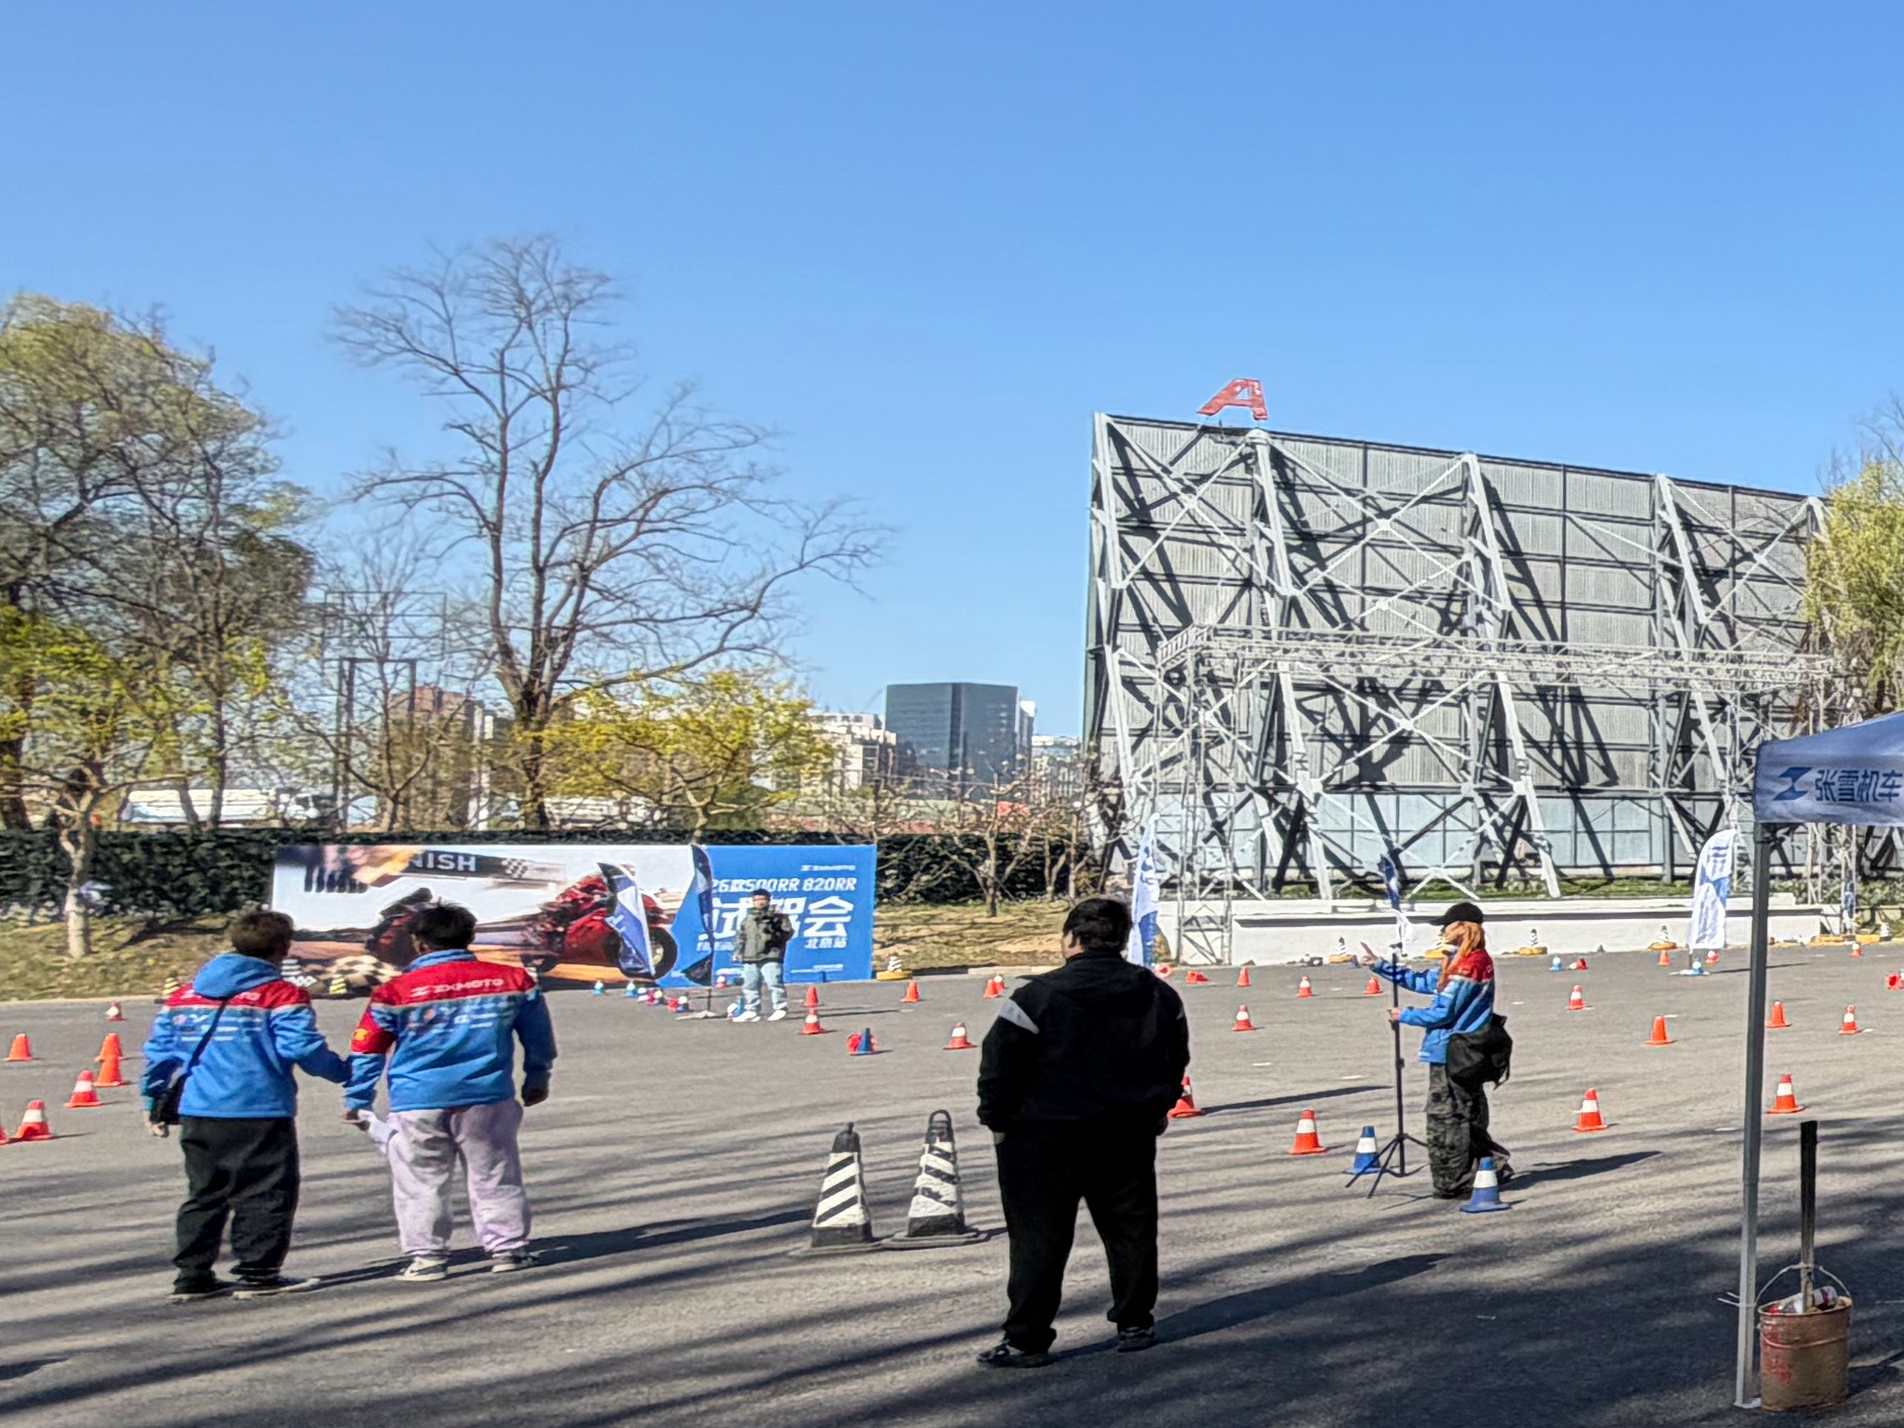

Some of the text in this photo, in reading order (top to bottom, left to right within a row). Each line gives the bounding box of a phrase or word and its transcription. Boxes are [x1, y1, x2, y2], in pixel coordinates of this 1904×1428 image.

[1196, 378, 1268, 420] A
[1815, 769, 1903, 803] 张雪机车
[802, 877, 858, 892] 820RR
